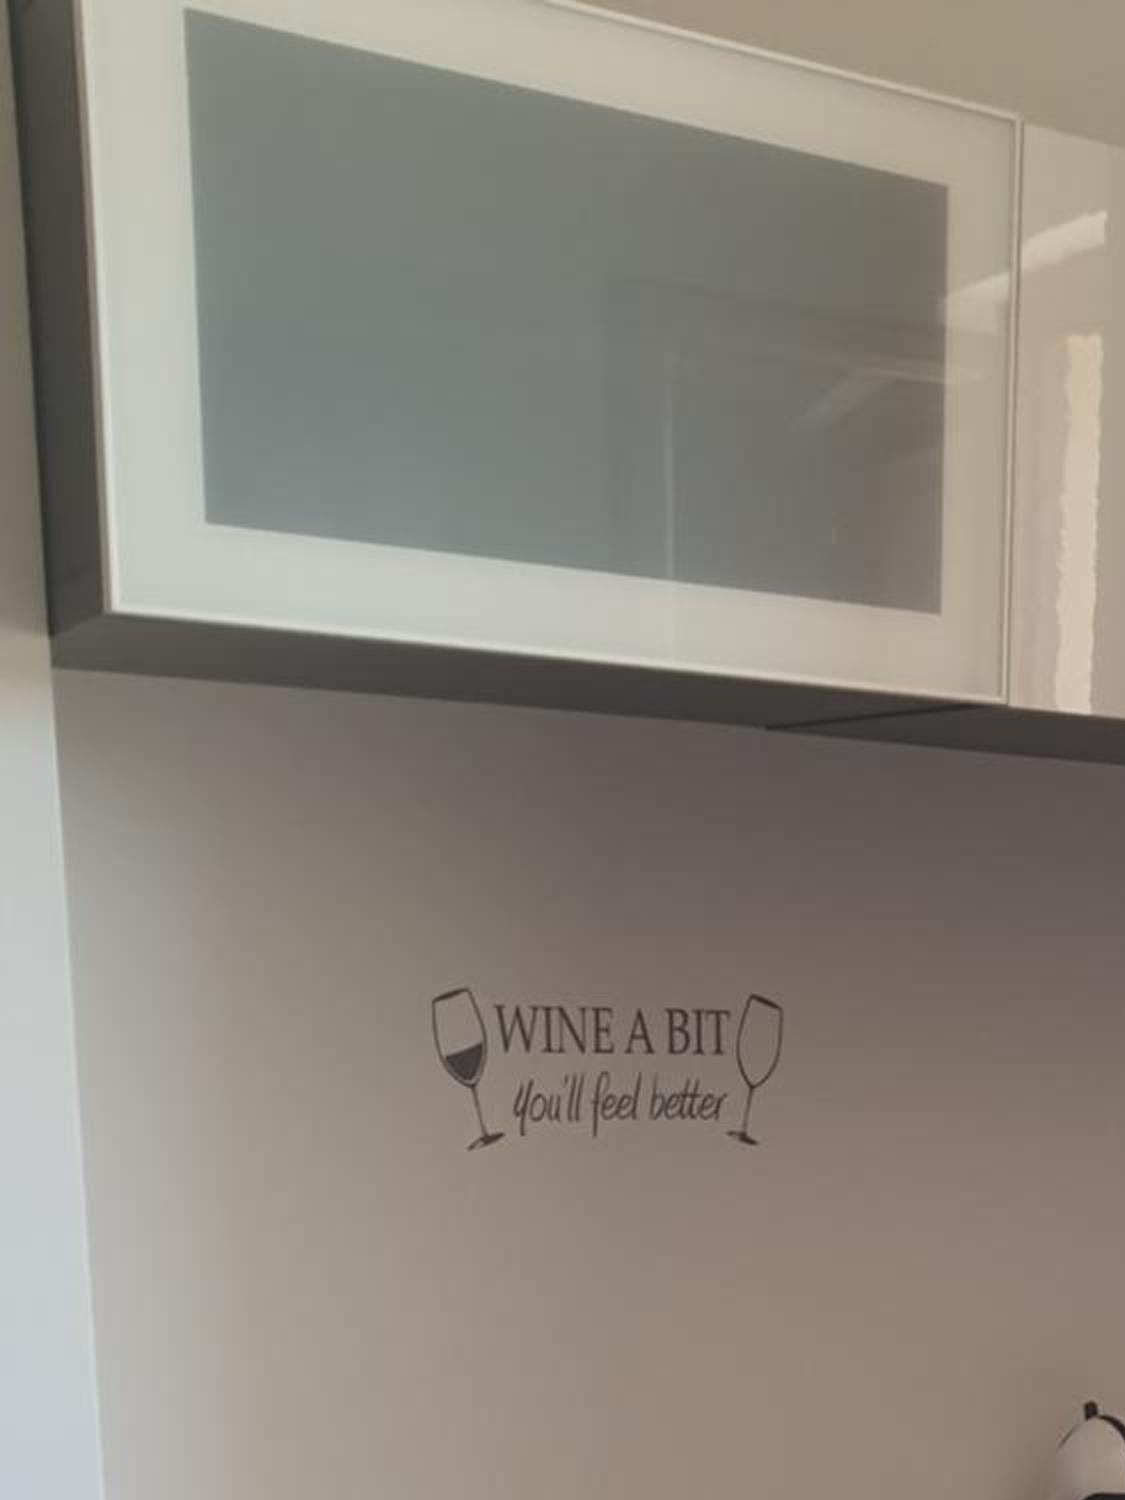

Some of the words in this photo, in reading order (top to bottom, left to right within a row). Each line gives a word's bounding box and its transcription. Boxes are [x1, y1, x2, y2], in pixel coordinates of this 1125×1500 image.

[494, 1004, 614, 1054] WINE
[624, 1009, 655, 1054] A
[664, 1008, 731, 1056] BIT
[590, 1071, 643, 1139] feel
[650, 1074, 728, 1121] better
